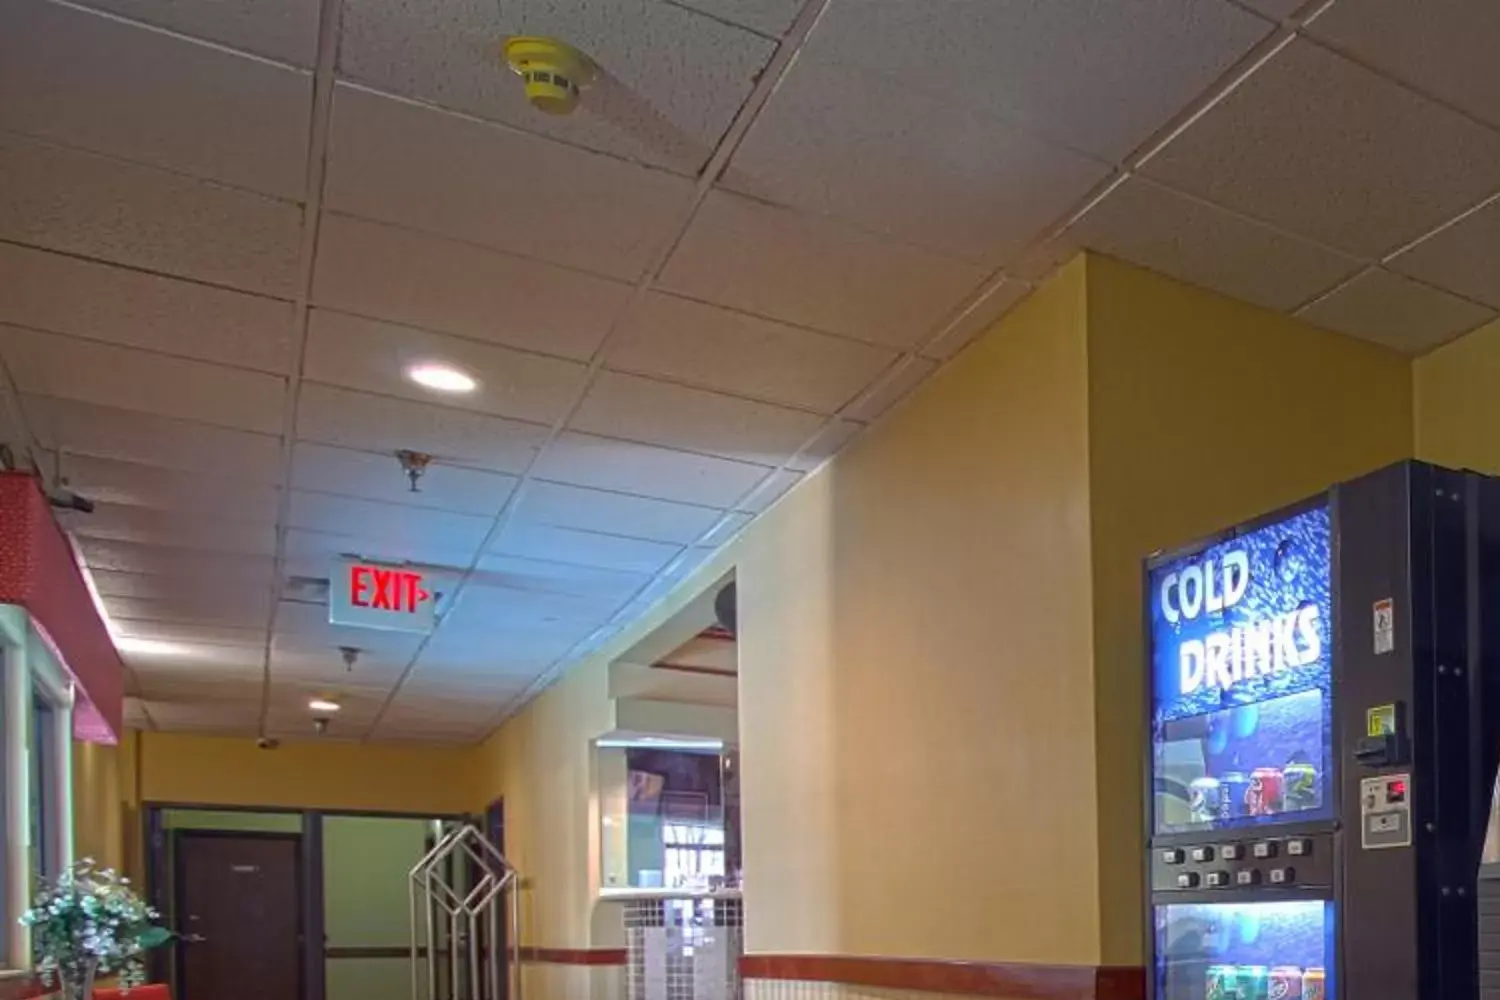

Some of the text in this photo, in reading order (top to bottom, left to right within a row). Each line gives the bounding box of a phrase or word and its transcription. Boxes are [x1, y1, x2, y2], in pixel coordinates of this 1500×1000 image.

[351, 566, 422, 613] EXIT
[1161, 550, 1249, 623] COLD
[1179, 604, 1321, 694] DRINKS
